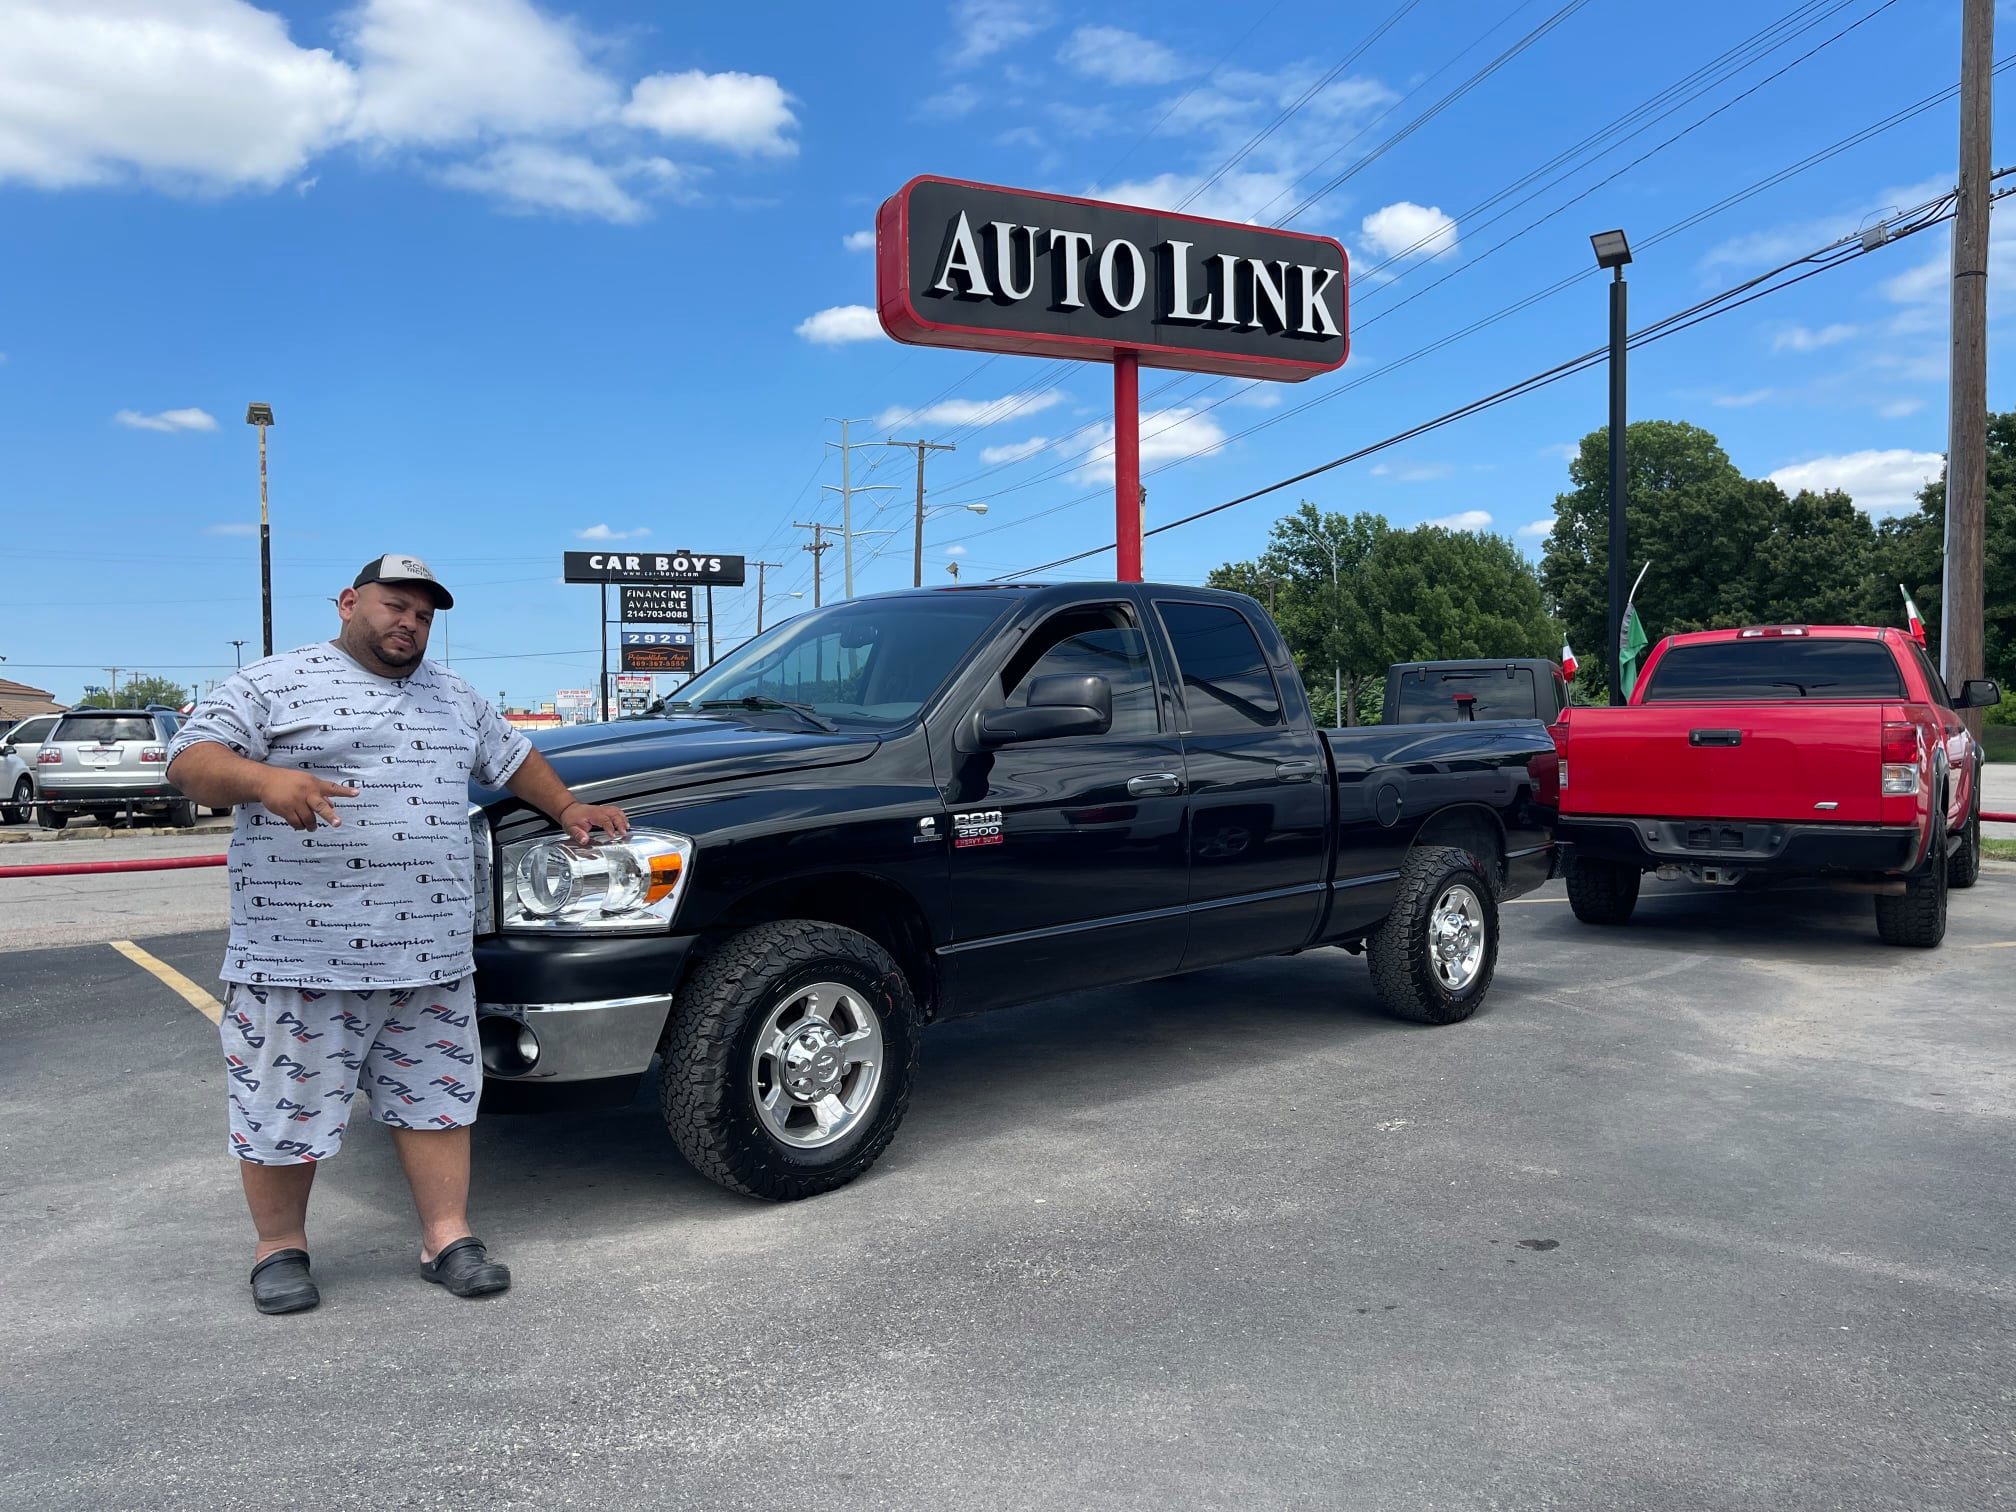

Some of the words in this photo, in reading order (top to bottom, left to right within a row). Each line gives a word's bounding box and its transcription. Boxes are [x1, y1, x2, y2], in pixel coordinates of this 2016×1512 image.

[934, 209, 1146, 312] AUTO
[1167, 239, 1342, 337] LINK
[589, 556, 640, 571] CAR
[655, 557, 722, 573] BOYS
[626, 590, 687, 599] FINANCING
[628, 600, 687, 609] AVAILABLE
[626, 610, 688, 618] 214-703-0088
[289, 695, 349, 710] Champion
[334, 708, 405, 718] Champion
[319, 724, 373, 734] Champion
[393, 722, 448, 734] Champion
[352, 741, 396, 750] Champion
[411, 740, 470, 754] Champion
[298, 761, 361, 772] Champion
[381, 756, 437, 767] Champion
[334, 802, 380, 811] hampion
[407, 796, 460, 808] Champion
[357, 819, 409, 827] Champion
[425, 815, 469, 830] Champio
[392, 832, 449, 843] Champion
[960, 827, 999, 837] 2500
[302, 839, 369, 850] Champion
[267, 855, 321, 866] Champion
[346, 858, 436, 872] Champion
[326, 880, 385, 891] Champion
[252, 896, 334, 912] Champion
[361, 899, 414, 907] Champion
[395, 911, 454, 921] Champion
[306, 919, 372, 931] Champion
[271, 934, 324, 944] Champion
[348, 937, 435, 950] Champion
[327, 958, 386, 968] Champion
[250, 972, 334, 987] Champion
[420, 1004, 470, 1027] FILA
[228, 1012, 265, 1049] FILA
[276, 1011, 325, 1043] FILA
[425, 1040, 475, 1065] FILA
[273, 1055, 321, 1083] FILA
[377, 1075, 425, 1105] FILA
[429, 1075, 476, 1104] FILA
